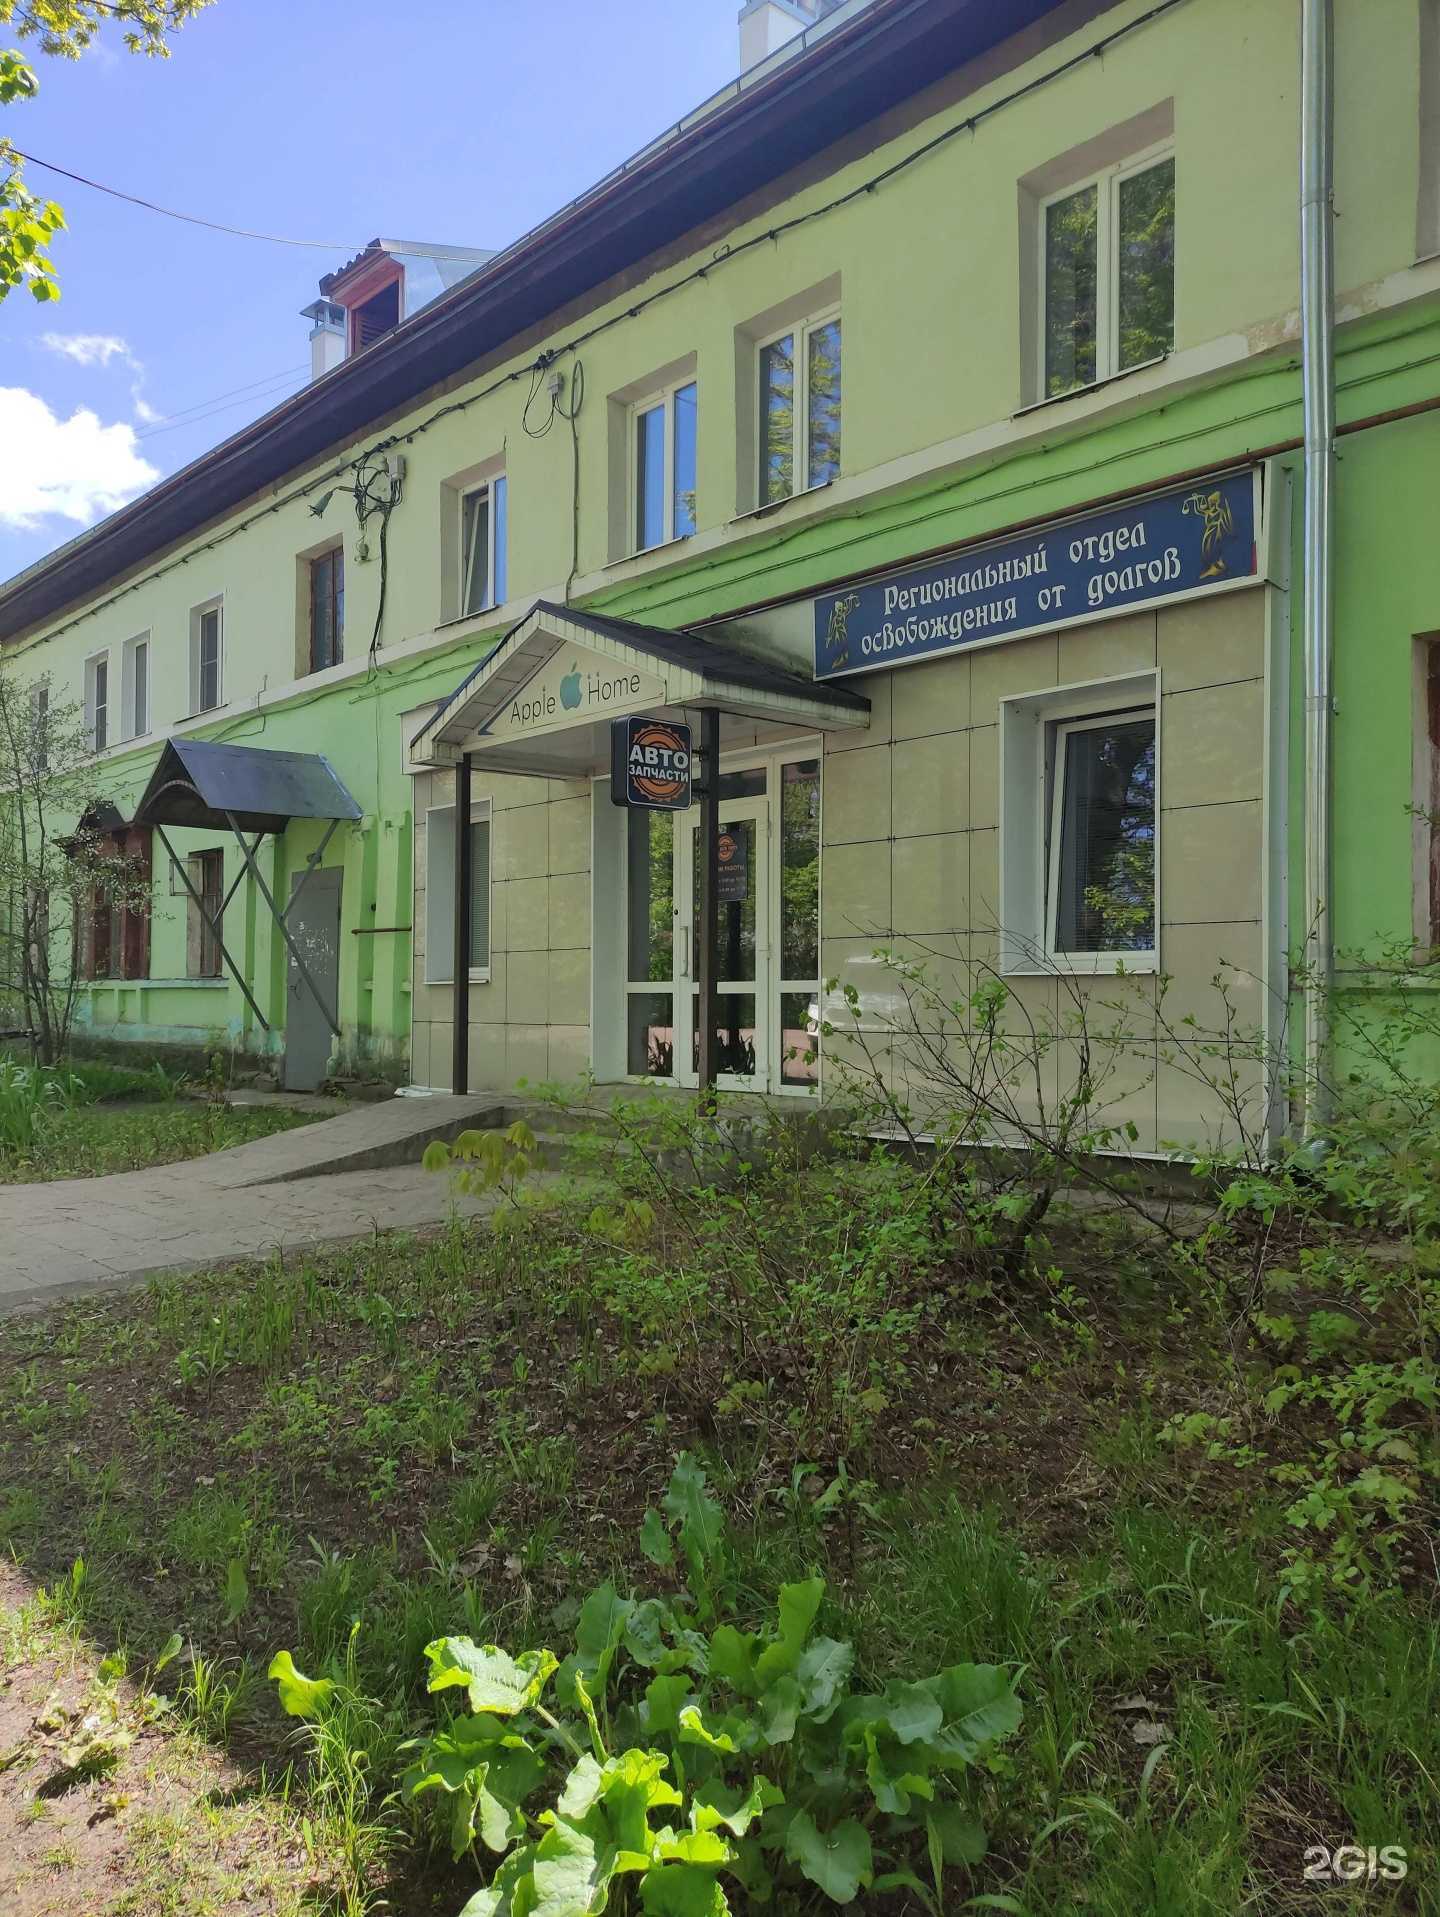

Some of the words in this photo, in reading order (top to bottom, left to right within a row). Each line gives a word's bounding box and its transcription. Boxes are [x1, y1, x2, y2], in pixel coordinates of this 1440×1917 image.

[884, 543, 1048, 615] Региональный
[1069, 522, 1146, 563] отдел
[861, 596, 1017, 655] освобождения
[1037, 585, 1066, 611] от
[1087, 548, 1181, 605] долгов
[588, 672, 640, 704] Home
[629, 744, 689, 769] АВТО
[629, 764, 689, 783] ЗАПЧАСТИ
